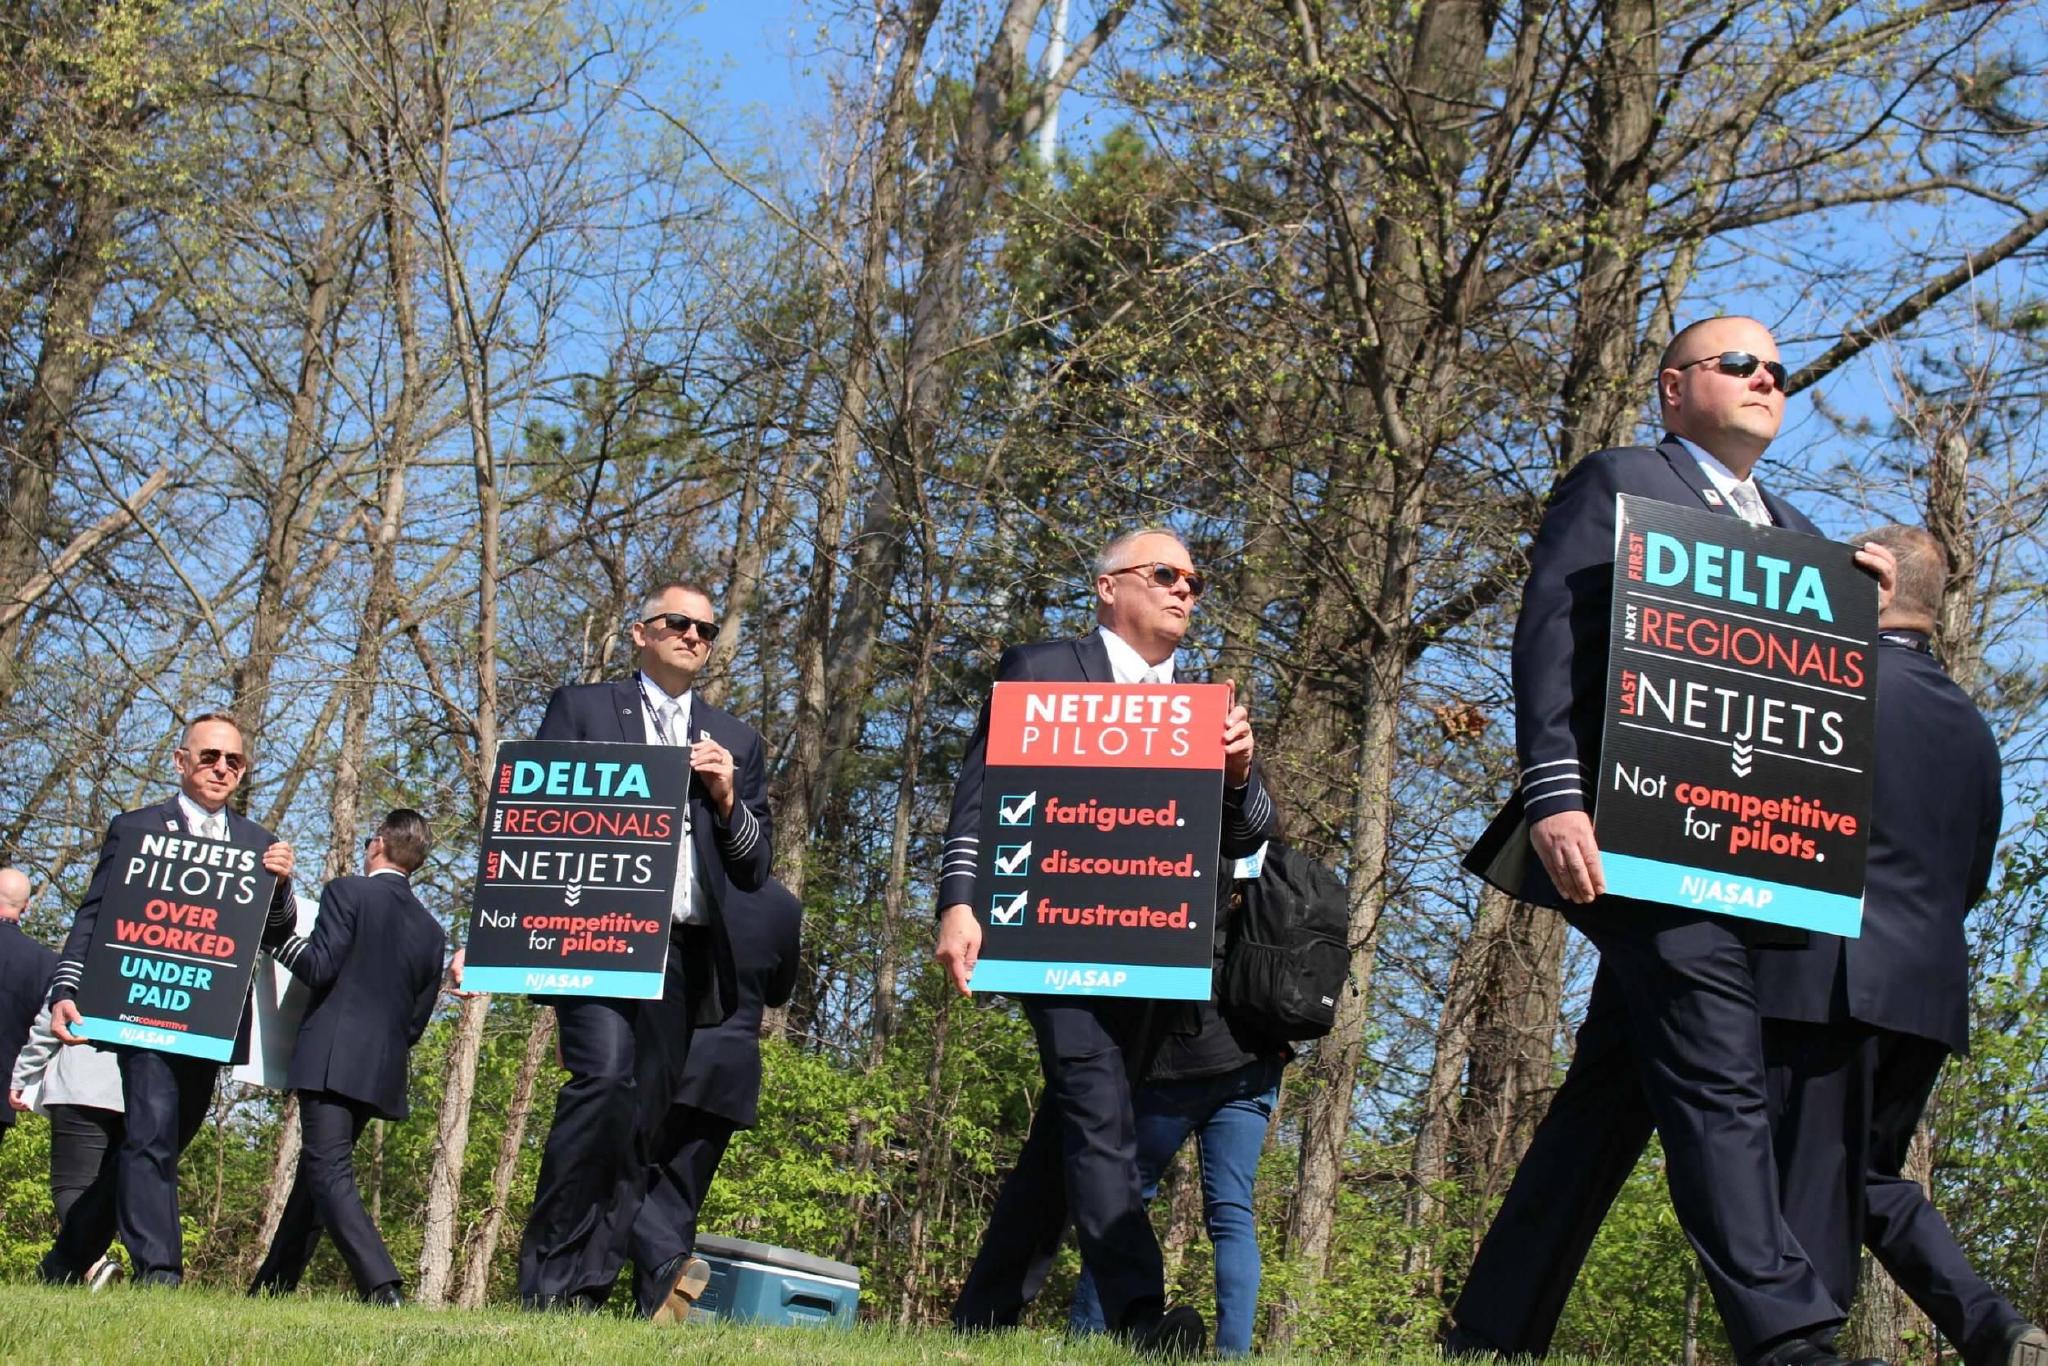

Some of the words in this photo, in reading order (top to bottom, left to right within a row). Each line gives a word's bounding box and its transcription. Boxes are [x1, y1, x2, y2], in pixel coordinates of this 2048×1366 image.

[1628, 533, 1643, 580] FIRST
[1646, 532, 1834, 623] DELTA
[1624, 604, 1638, 640] NEXT
[1642, 608, 1864, 688] REGIONALS
[1025, 694, 1191, 724] NETJETS
[1620, 670, 1636, 715] LAST
[1637, 672, 1844, 756] NETJETS
[1022, 727, 1189, 756] PILOTS
[499, 764, 513, 794] FIRST
[511, 761, 650, 798] DELTA
[1044, 797, 1185, 831] fatigued.
[1614, 762, 1666, 798] Not
[1674, 782, 1857, 836] competitive
[493, 809, 503, 832] NEXT
[505, 809, 671, 837] REGIONALS
[1684, 808, 1720, 840] for
[1729, 822, 1824, 862] pilots.
[141, 834, 256, 871] NETJETS
[486, 852, 499, 879] LAST
[498, 850, 652, 884] NETJETS
[1041, 851, 1200, 878] discounted.
[124, 858, 256, 904] PILOTS
[144, 900, 218, 928] OVER
[480, 910, 517, 929] Not
[523, 912, 660, 933] competitive
[1037, 899, 1196, 929] frustrated.
[115, 920, 236, 958] WORKED
[529, 930, 556, 951] for
[560, 932, 634, 956] pilots.
[120, 955, 213, 990] UNDER
[128, 984, 191, 1011] PAID
